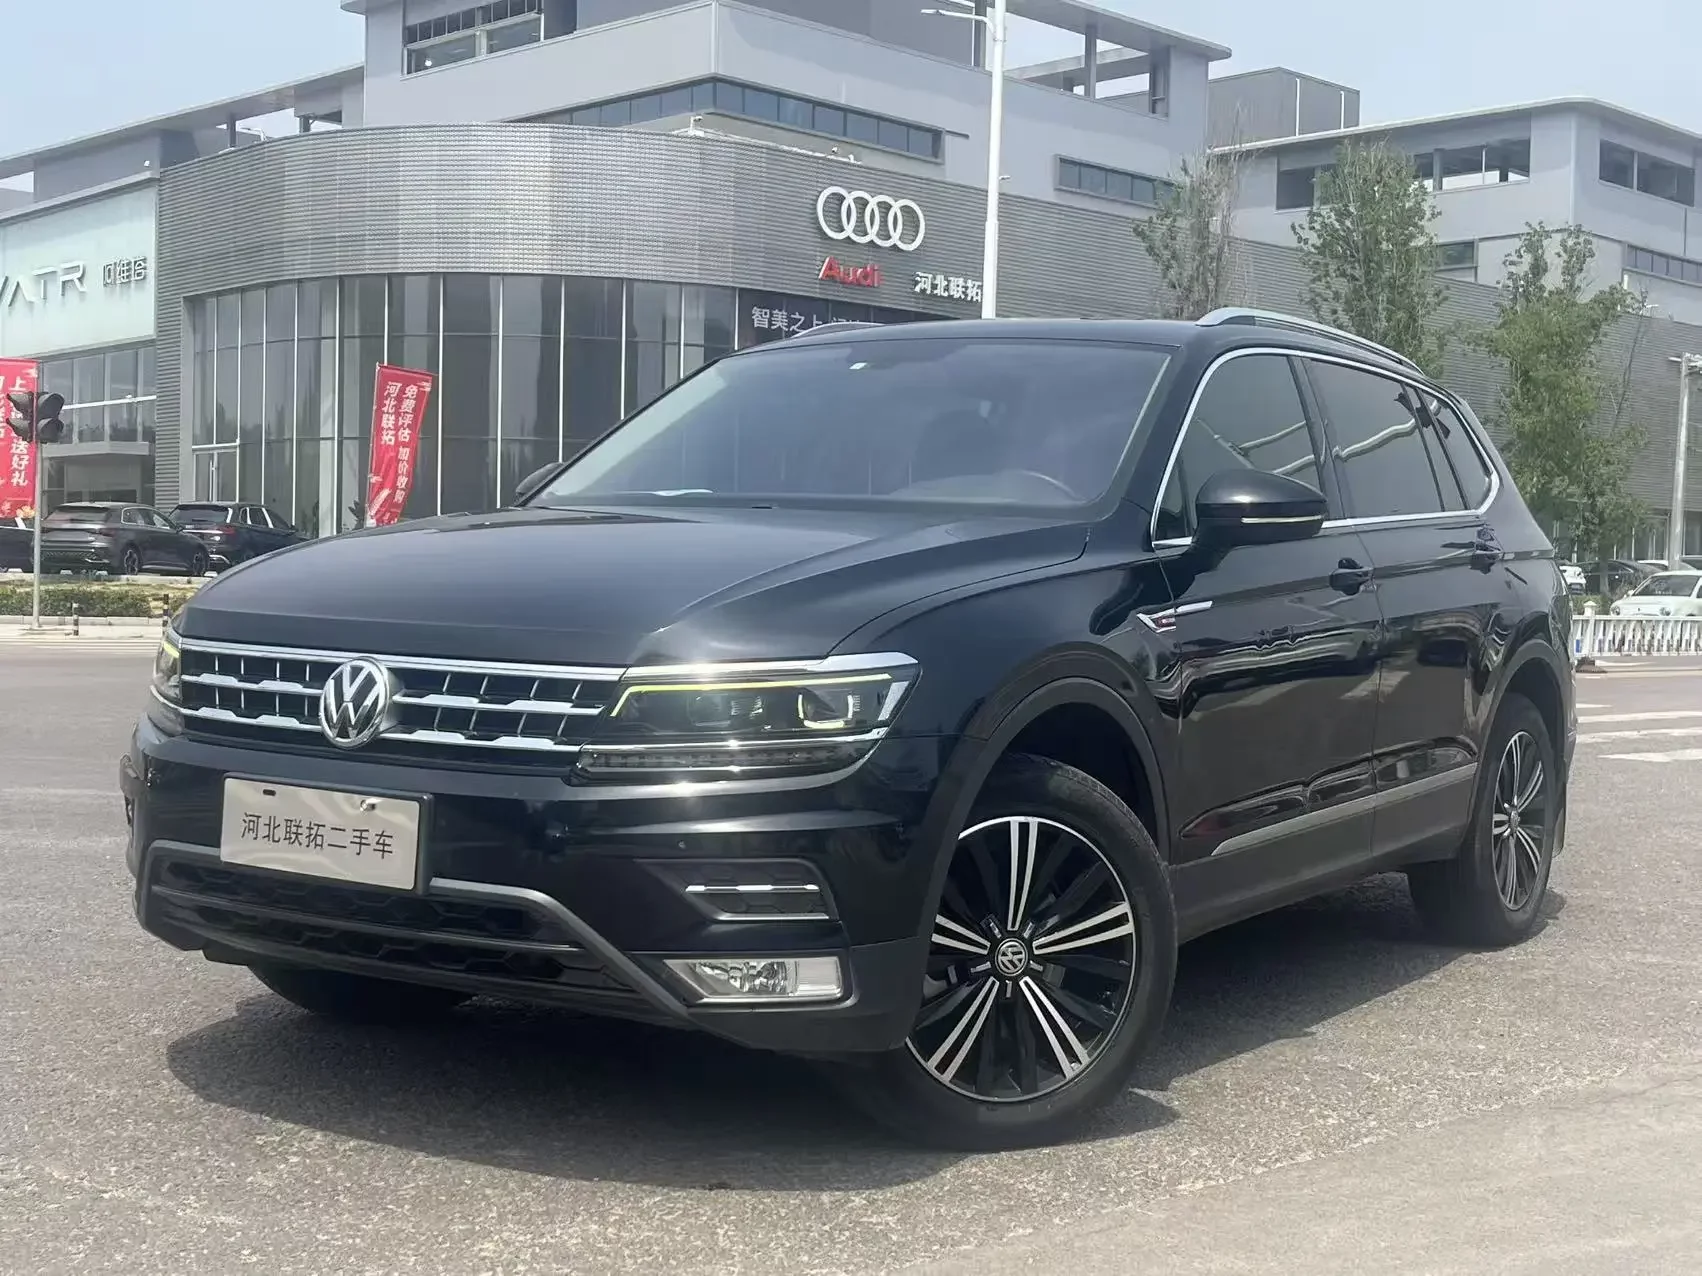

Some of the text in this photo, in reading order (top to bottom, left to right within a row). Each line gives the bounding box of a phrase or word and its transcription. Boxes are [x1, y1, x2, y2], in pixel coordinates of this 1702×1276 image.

[818, 255, 884, 288] Audi
[914, 271, 982, 303] 河北联拓
[380, 381, 402, 446] 河北联拓
[397, 384, 418, 442] 免费评估
[241, 811, 394, 860] 河北联拓二手车
